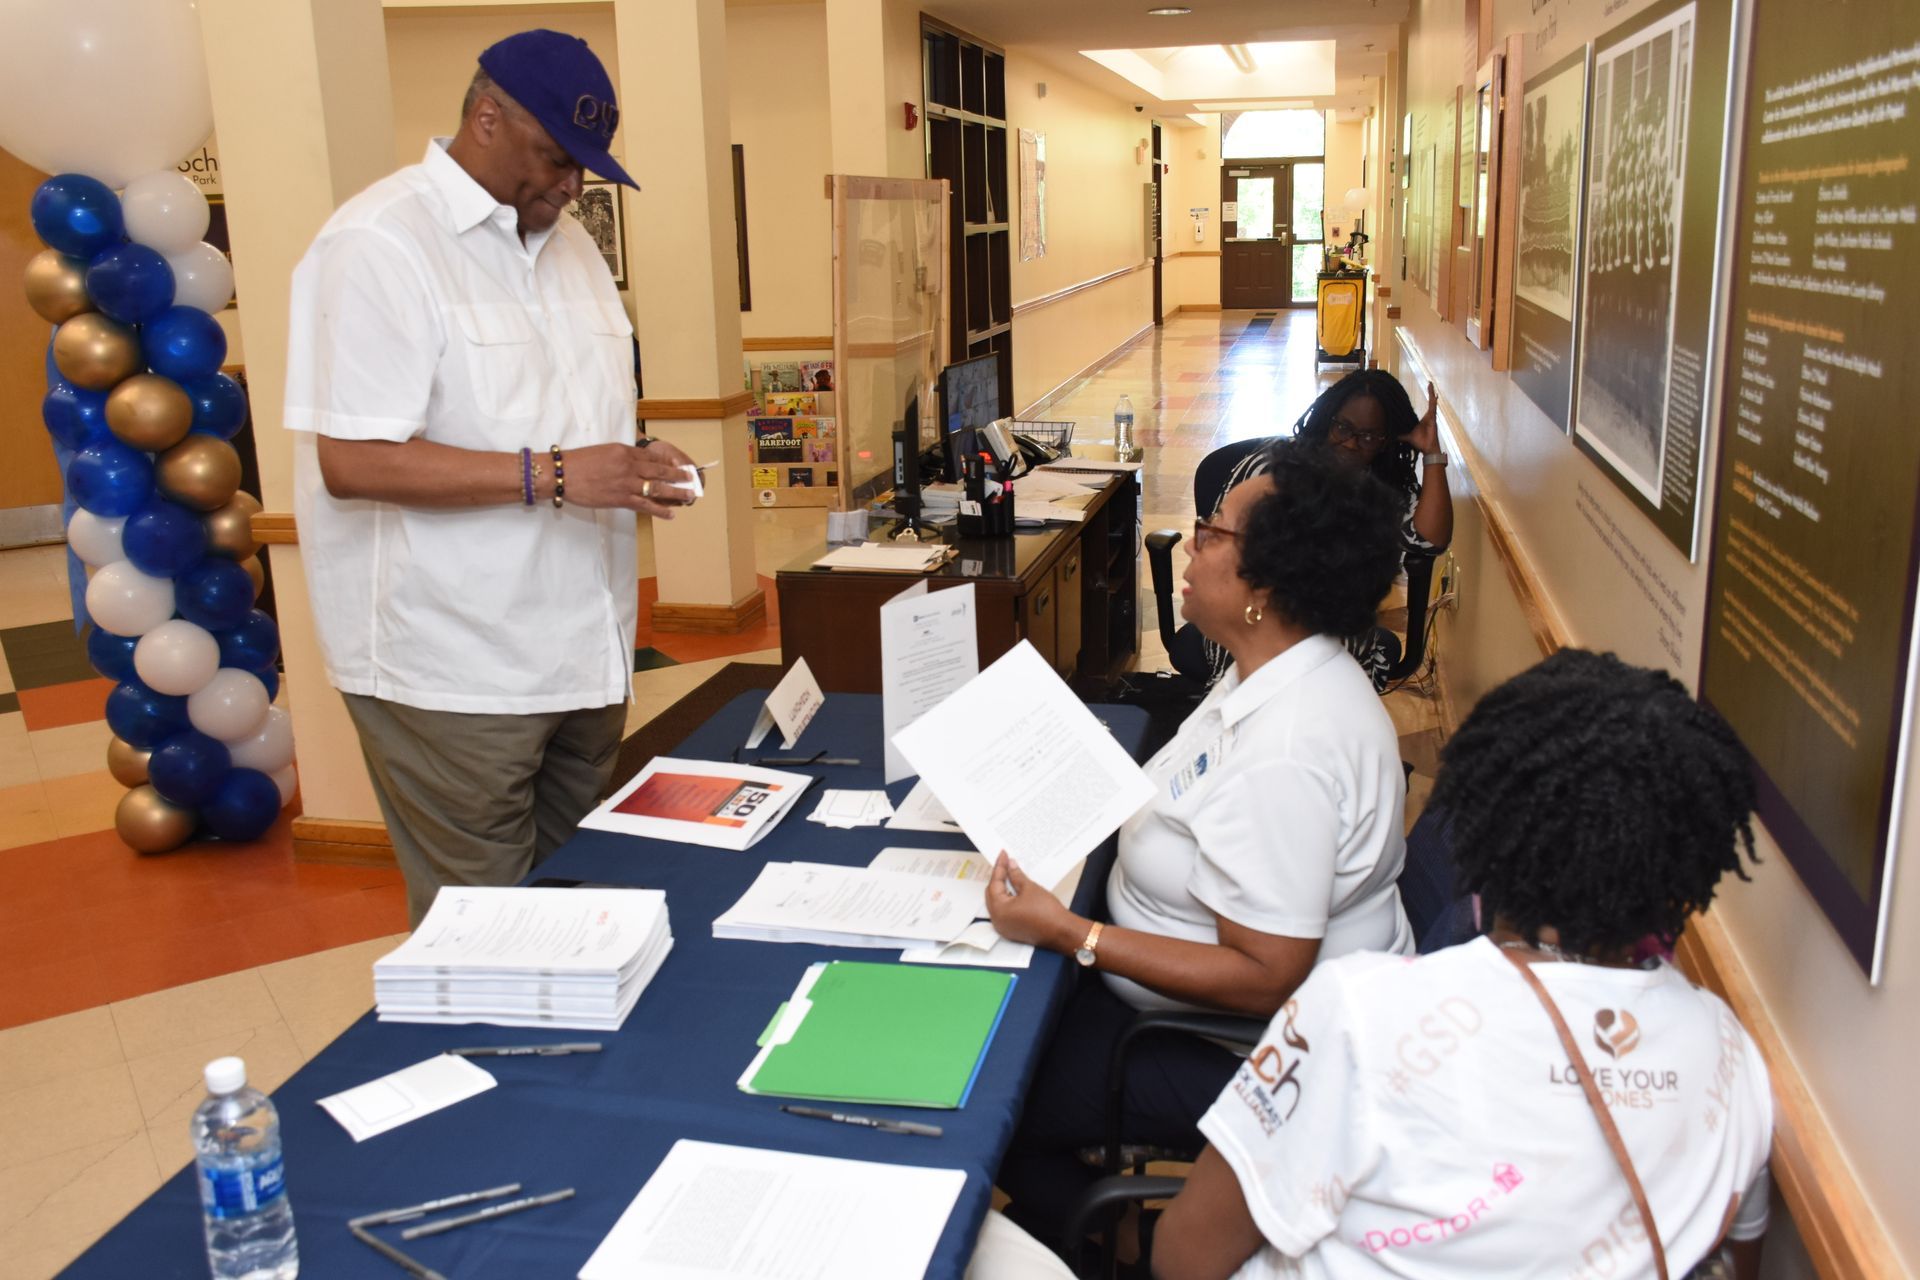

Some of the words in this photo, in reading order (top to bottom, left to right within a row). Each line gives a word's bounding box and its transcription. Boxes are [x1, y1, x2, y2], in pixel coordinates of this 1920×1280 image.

[193, 175, 217, 185] Park
[759, 438, 802, 447] BAREFOOT
[735, 790, 770, 818] 50
[1618, 1069, 1679, 1091] YOUR
[1588, 1088, 1654, 1110] ONES
